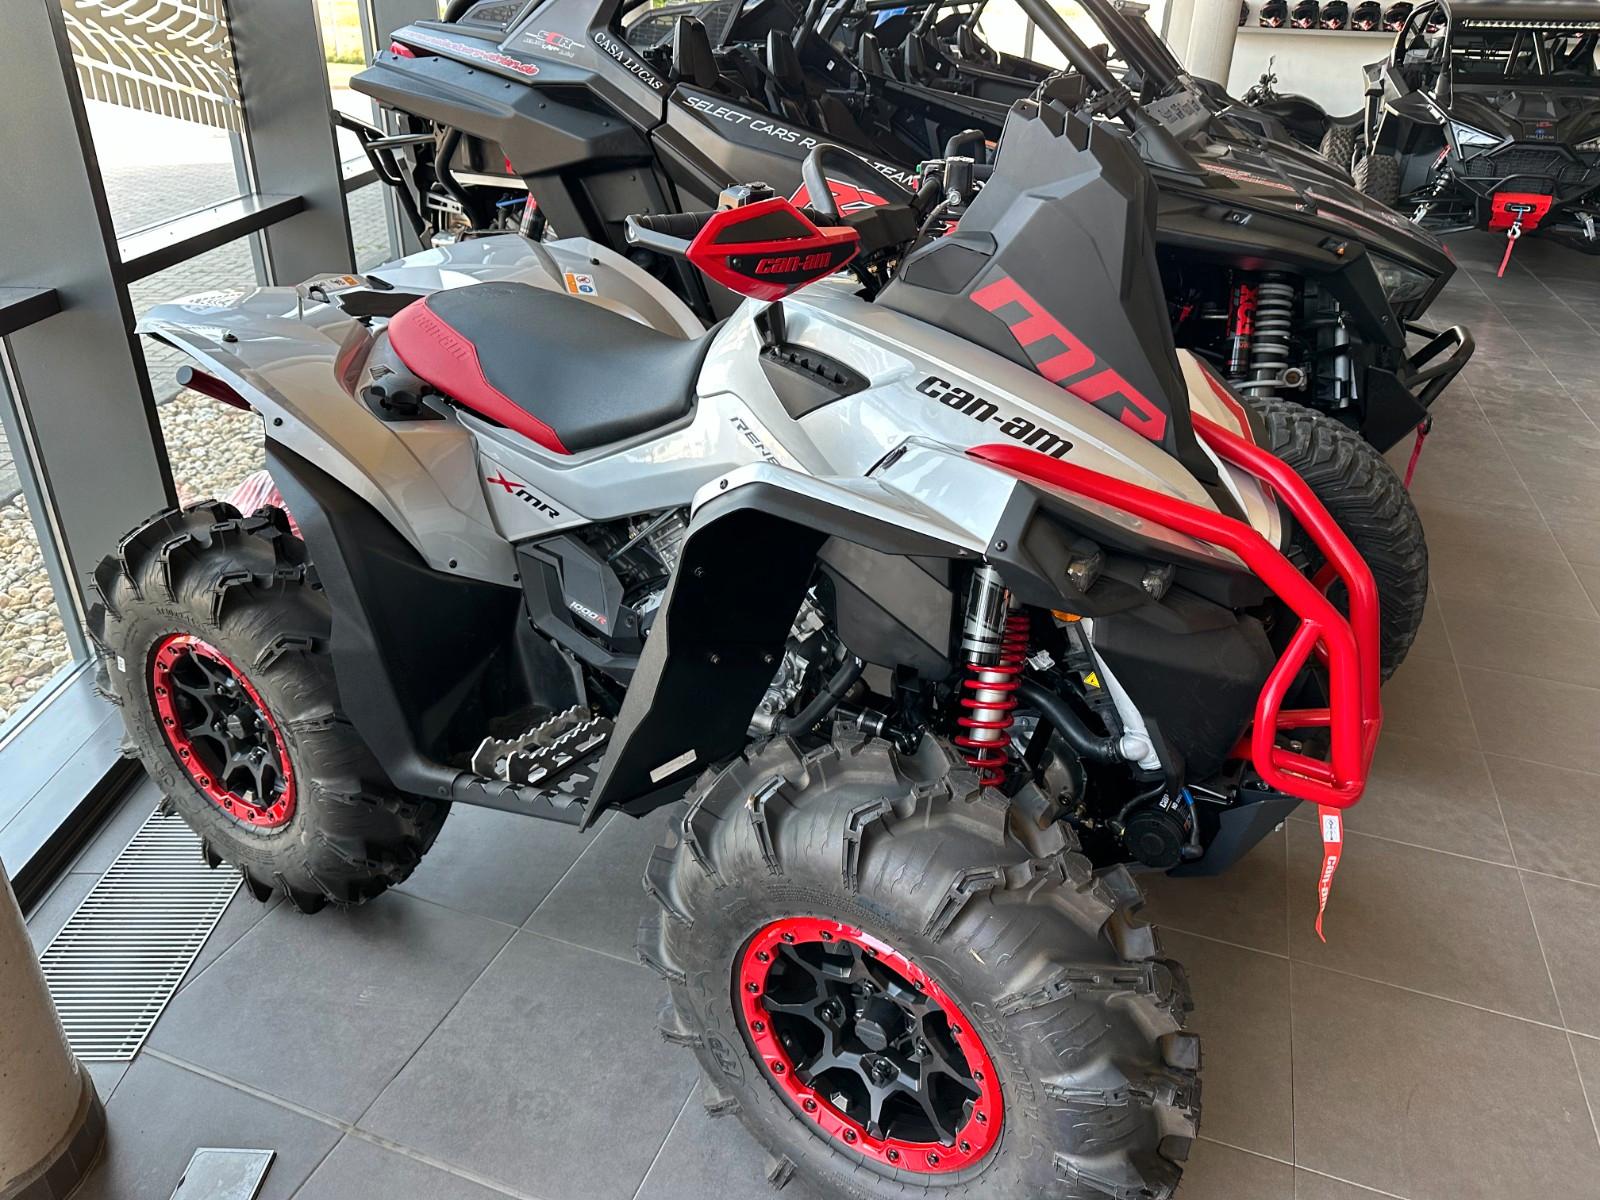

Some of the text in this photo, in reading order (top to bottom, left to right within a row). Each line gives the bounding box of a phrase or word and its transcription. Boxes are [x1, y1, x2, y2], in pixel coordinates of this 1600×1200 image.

[594, 32, 664, 90] CASA LUCAS
[682, 96, 752, 124] SELECT
[749, 119, 801, 143] CARS
[755, 252, 832, 274] can-am
[915, 375, 1074, 459] can-am
[569, 601, 607, 625] 1000R
